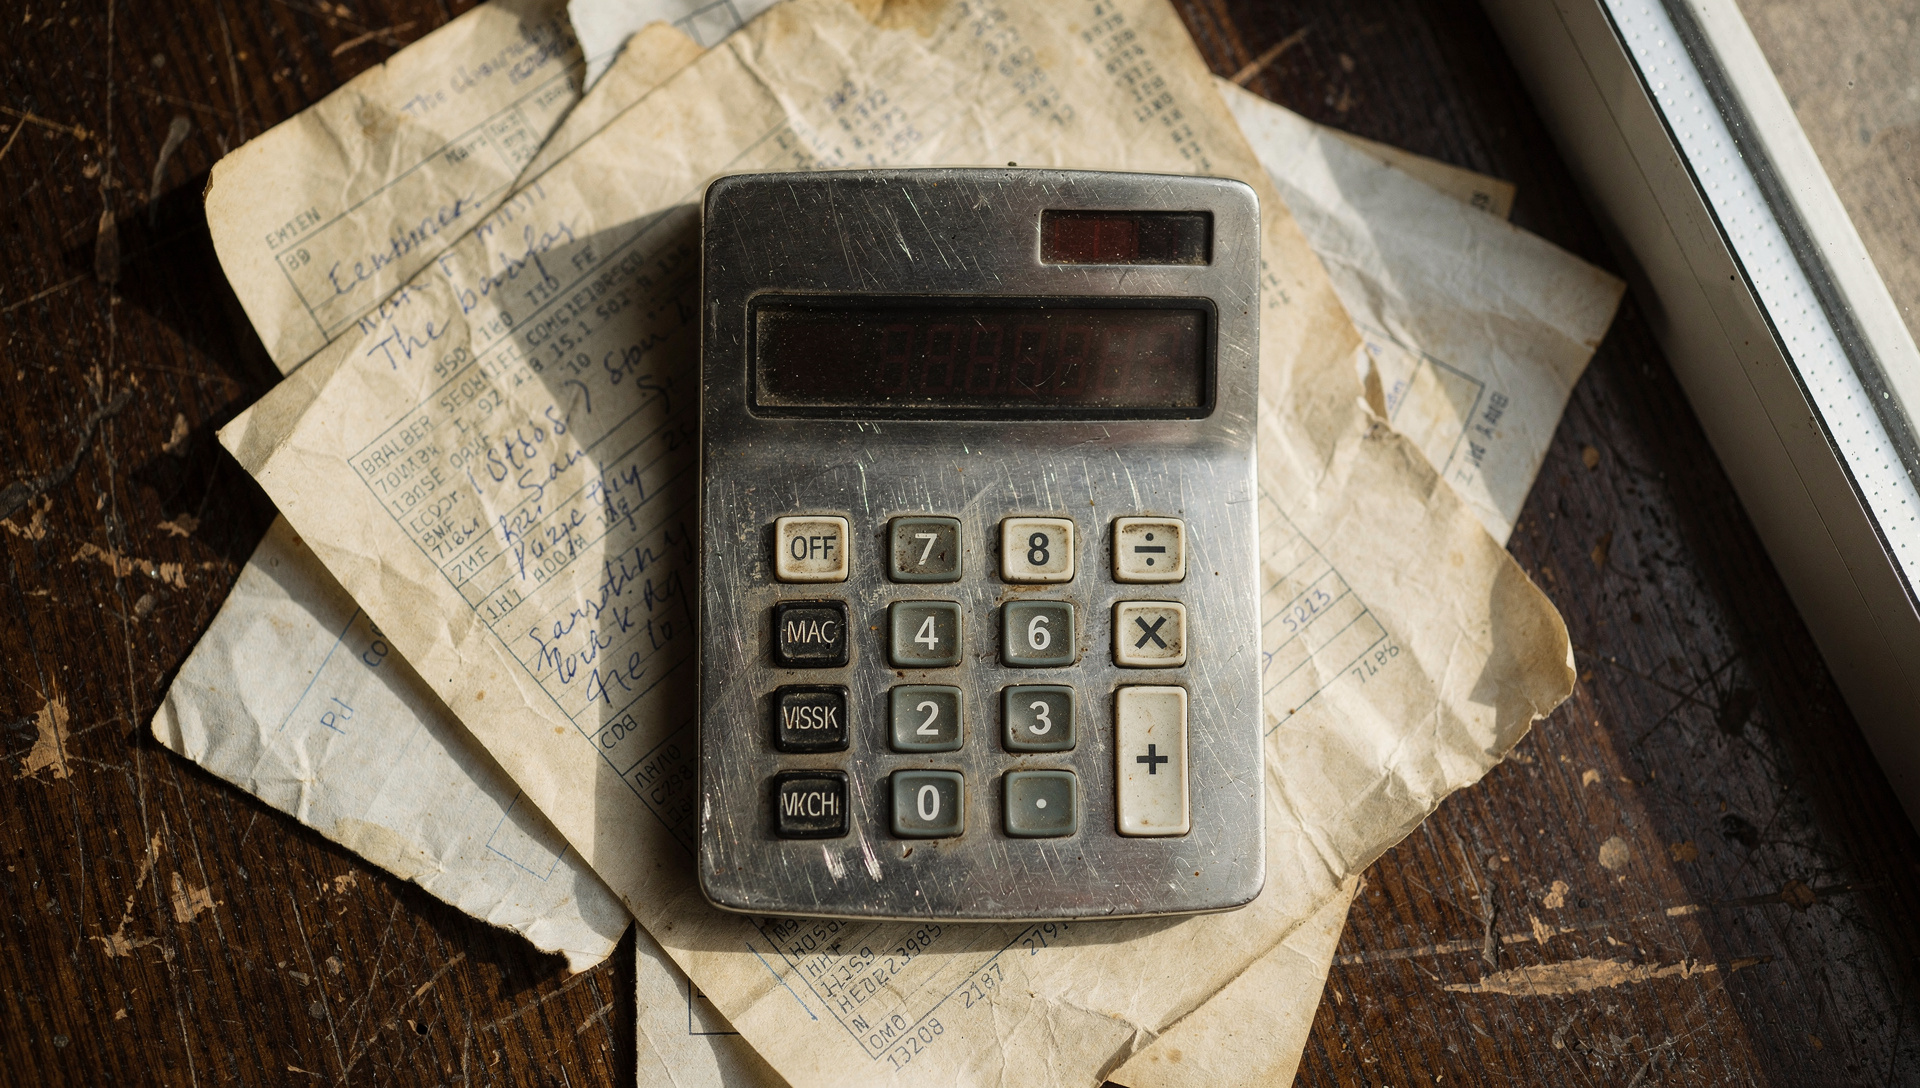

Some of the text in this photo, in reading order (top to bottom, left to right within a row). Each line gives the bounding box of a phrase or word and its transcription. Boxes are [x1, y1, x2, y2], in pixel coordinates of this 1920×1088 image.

[367, 317, 450, 370] The
[790, 534, 838, 561] OFF
[914, 532, 938, 566] 7
[1027, 531, 1050, 566] 8
[787, 620, 836, 644] MAC
[914, 615, 939, 650] 4
[1027, 614, 1051, 650] 6
[915, 700, 940, 736] 2
[1028, 700, 1052, 736] 3
[959, 963, 1003, 1009] 2187
